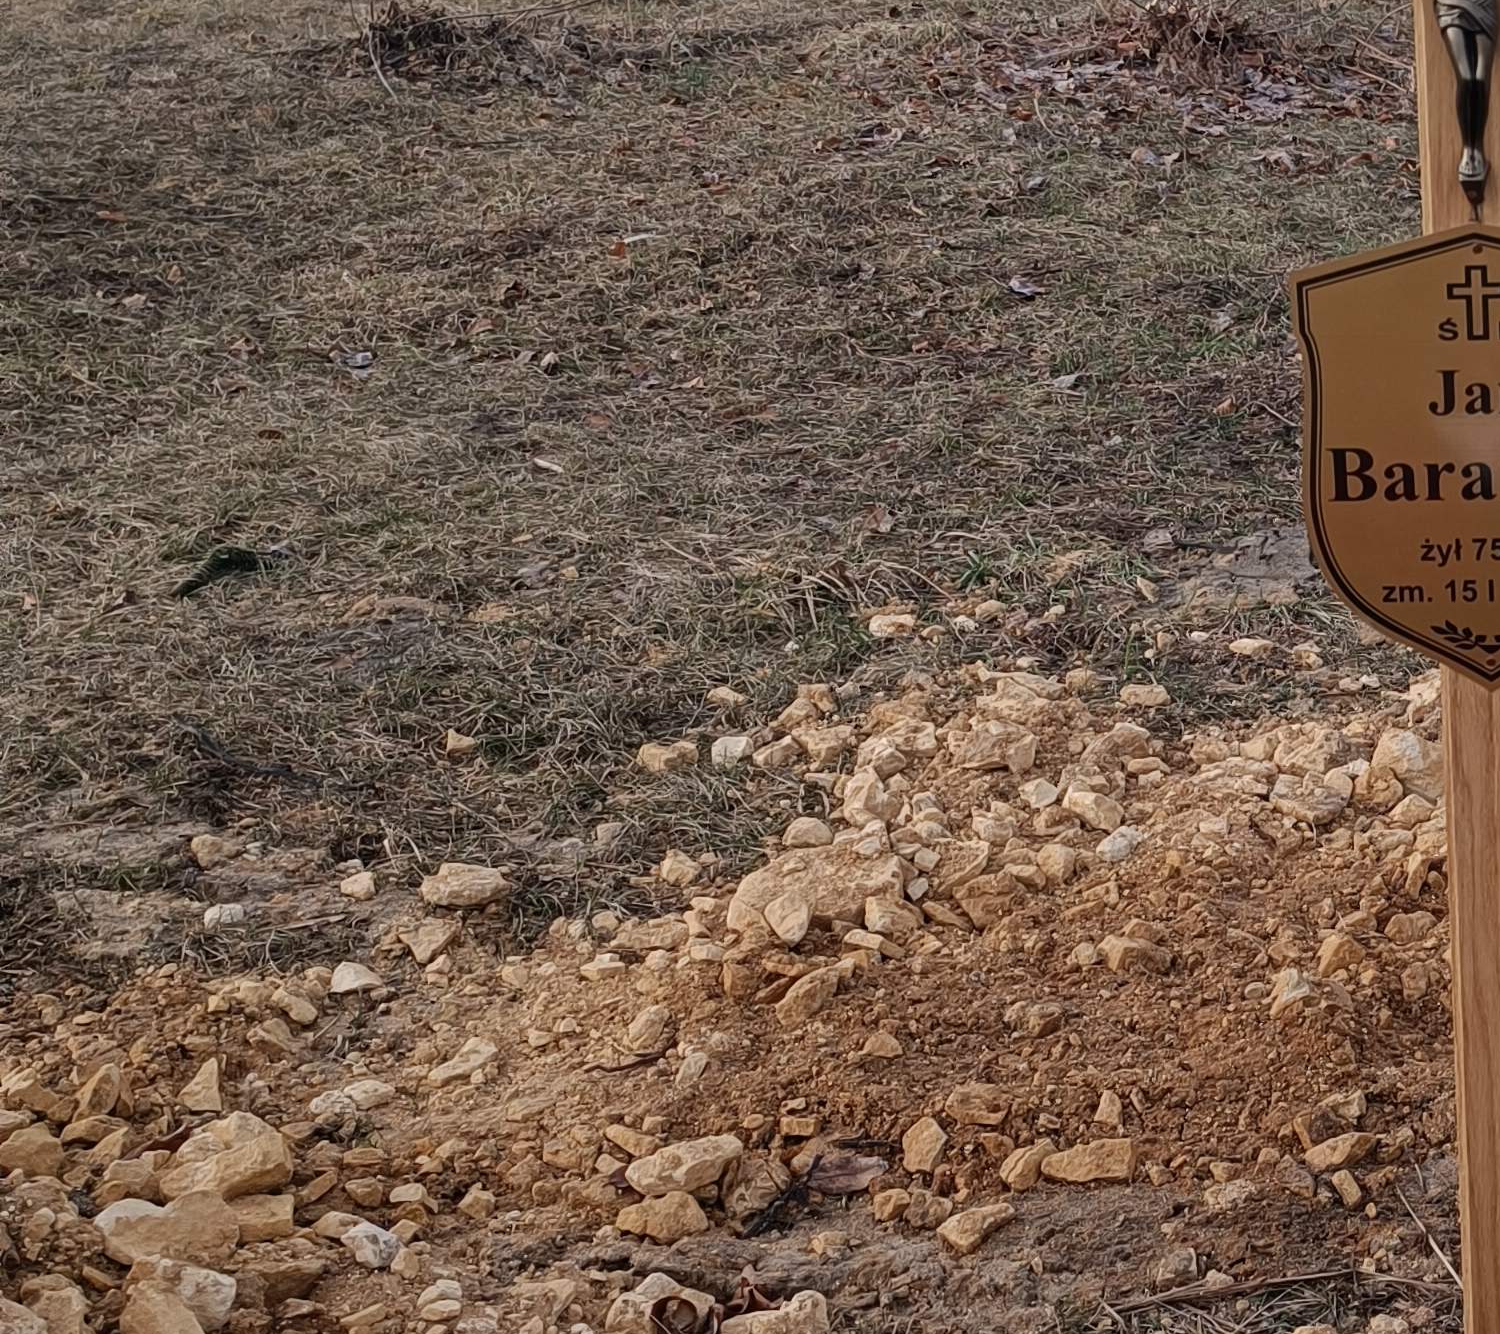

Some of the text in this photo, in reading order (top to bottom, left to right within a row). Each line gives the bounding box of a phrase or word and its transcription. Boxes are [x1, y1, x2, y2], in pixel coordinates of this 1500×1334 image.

[1438, 317, 1459, 341] Ś
[1420, 537, 1463, 567] żył
[1382, 585, 1433, 603] zm.
[1444, 579, 1478, 603] 15
